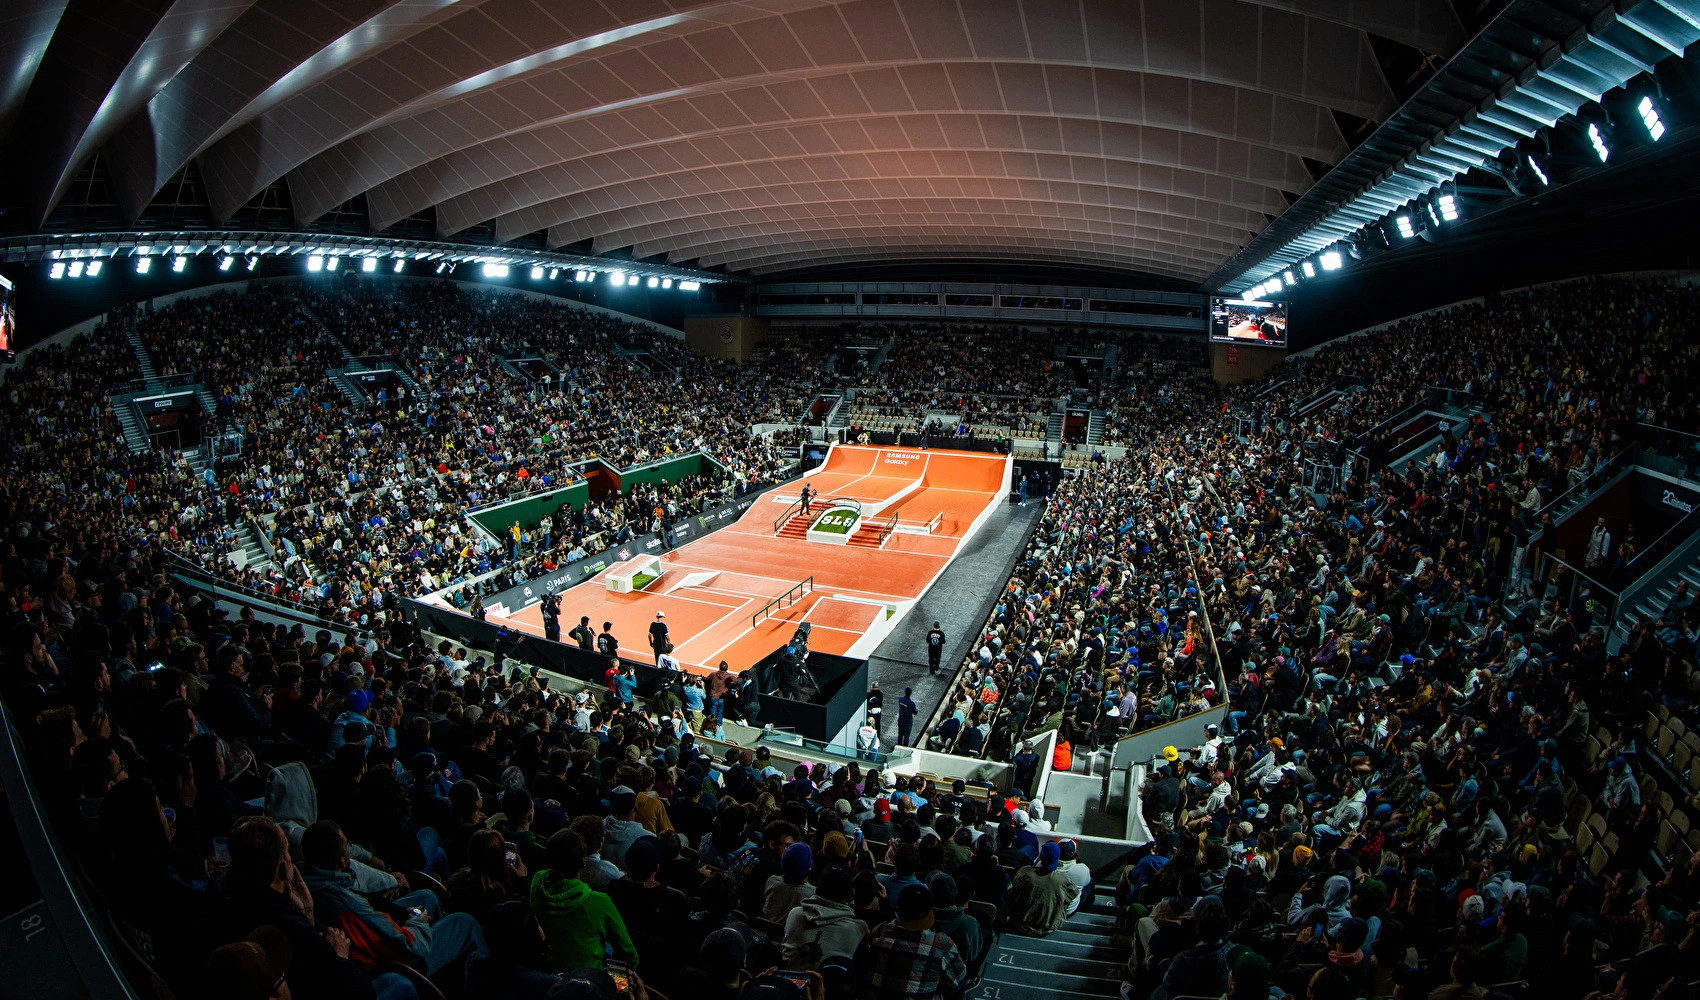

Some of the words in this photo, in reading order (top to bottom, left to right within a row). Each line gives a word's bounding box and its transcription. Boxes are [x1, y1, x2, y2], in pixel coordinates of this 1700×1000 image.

[884, 458, 909, 466] Galaxy
[886, 452, 920, 460] SAMSUNG
[821, 515, 854, 527] SLS
[553, 574, 572, 587] PARIS
[20, 914, 46, 942] 18
[998, 953, 1015, 965] 12
[1106, 968, 1122, 979] 12
[982, 986, 1001, 1000] 13
